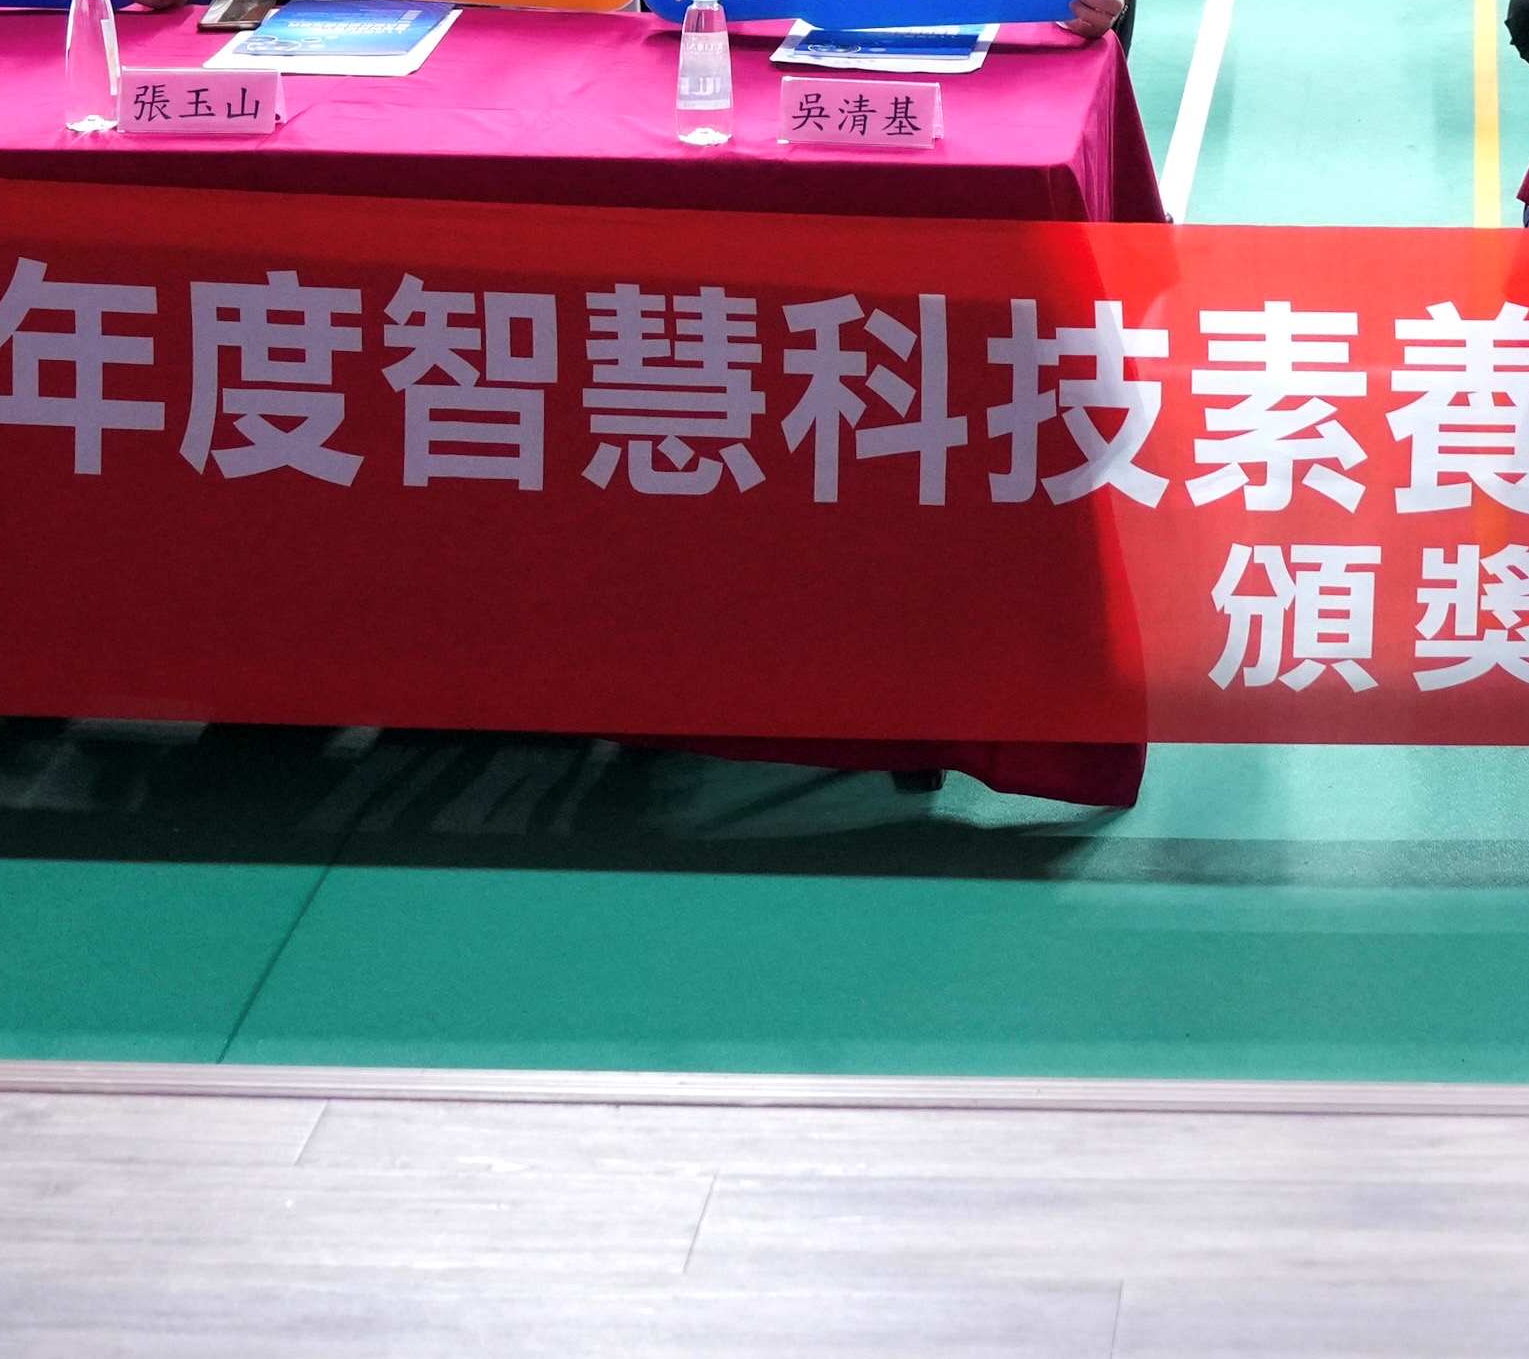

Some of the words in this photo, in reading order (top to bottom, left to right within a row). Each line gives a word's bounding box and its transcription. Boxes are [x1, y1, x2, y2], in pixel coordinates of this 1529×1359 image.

[133, 83, 262, 124] 張玉山
[792, 92, 922, 138] 吳清基
